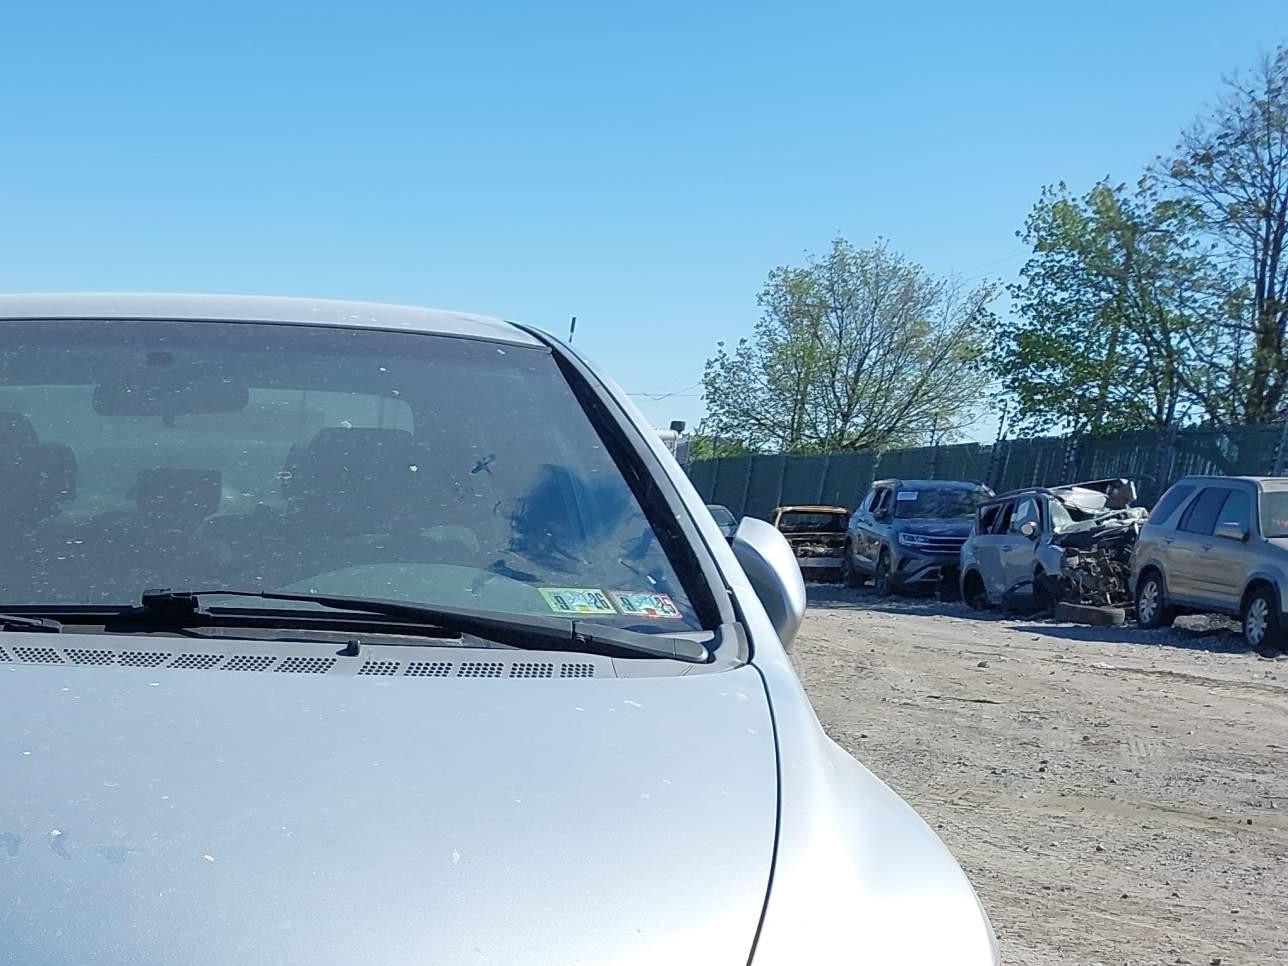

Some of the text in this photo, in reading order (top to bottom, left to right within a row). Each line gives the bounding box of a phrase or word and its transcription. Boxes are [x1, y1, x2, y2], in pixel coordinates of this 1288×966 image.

[554, 592, 610, 610] 9 26
[620, 596, 676, 614] 9 25
